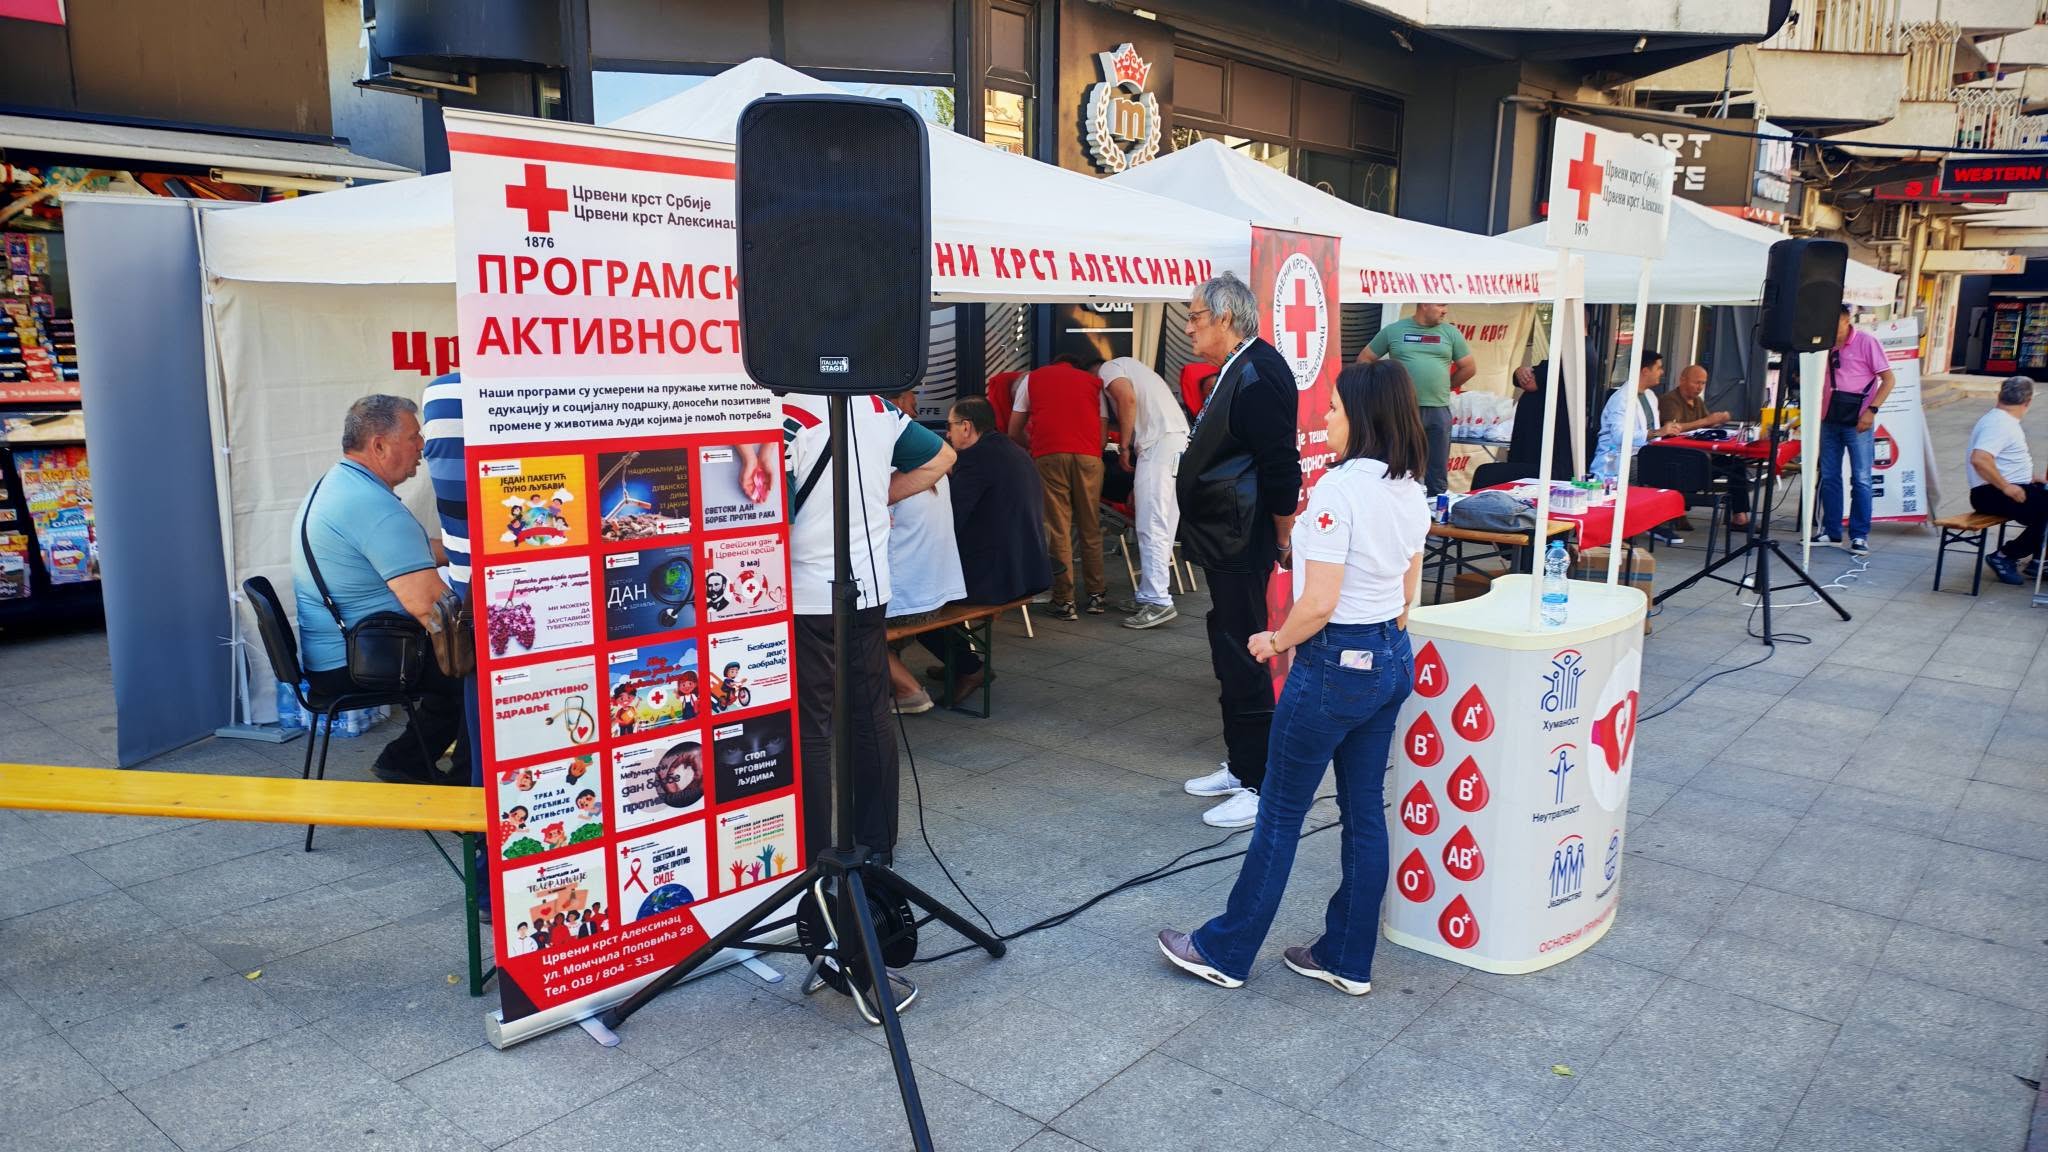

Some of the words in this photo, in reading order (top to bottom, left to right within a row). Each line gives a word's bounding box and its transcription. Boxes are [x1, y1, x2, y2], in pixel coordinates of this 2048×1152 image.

[1605, 159, 1630, 183] Црвени
[1628, 170, 1643, 188] крст
[1643, 168, 1662, 193] Србиј
[1954, 166, 2043, 182] WESTERN
[573, 185, 627, 203] Црвени
[631, 193, 662, 207] крст
[666, 193, 712, 212] Србије
[1602, 184, 1627, 208] Црвени
[1626, 195, 1641, 212] крст
[574, 204, 628, 222] Црвени
[632, 213, 664, 226] крст
[1574, 222, 1589, 237] 1876
[524, 235, 555, 248] 1876
[931, 242, 980, 277] НИ
[990, 247, 1058, 280] КРСТ
[1069, 252, 1212, 286] АЛЕКСИНАЦ
[477, 254, 741, 300] ПРОГРАМСК
[1359, 269, 1419, 297] ЦРВЕНИ
[1420, 273, 1456, 294] КРСТ
[1466, 272, 1540, 296] АЛЕКСИНАЦ
[476, 316, 743, 356] АКТИВНОСТ
[1480, 323, 1509, 344] крст
[392, 331, 460, 376] Цр
[479, 388, 515, 398] Наши
[517, 387, 576, 400] програми
[578, 388, 591, 397] су
[592, 385, 645, 397] усмерени
[647, 385, 660, 393] на
[662, 384, 706, 395] пружање
[708, 383, 738, 391] хитне
[488, 403, 549, 417] едукацију
[552, 404, 560, 412] и
[563, 401, 619, 413] социјалну
[621, 402, 671, 412] подршку,
[672, 399, 719, 410] доносећи
[721, 397, 771, 406] позитивне
[489, 421, 542, 434] промене
[544, 421, 551, 431] у
[554, 418, 614, 430] животима
[616, 417, 645, 428] људи
[647, 415, 683, 426] којима
[684, 414, 693, 425] је
[695, 412, 727, 422] помоћ
[729, 411, 772, 420] потребна
[500, 476, 526, 486] ЈЕДАН
[528, 482, 565, 491] ЉУБАВИ
[704, 505, 737, 515] СВЕТСКИ
[739, 504, 755, 513] ДАН
[705, 515, 728, 525] БОРБЕ
[729, 512, 757, 522] ПРОТИВ
[758, 510, 776, 519] РАКА
[746, 558, 761, 568] мај
[607, 583, 647, 609] ДАН
[495, 683, 589, 706] РЕПРОДУКТИВНО
[495, 703, 551, 720] ЗДРАВЉЕ
[1542, 717, 1580, 732] Хуманост
[744, 750, 767, 761] СТОП
[734, 759, 777, 775] ТРГОВИНИ
[737, 771, 775, 786] ЉУДИМА
[534, 791, 554, 800] ТРКА
[621, 783, 645, 798] дан
[653, 870, 675, 886] СИДЕ
[542, 944, 590, 965] Црвени
[592, 933, 619, 951] крст
[620, 914, 682, 942] Алексинац
[1539, 928, 1583, 953] ОСНОВНИ
[543, 970, 561, 984] ул.
[563, 951, 620, 976] Момчила
[622, 932, 678, 956] Поповића
[679, 924, 694, 937] 28
[545, 984, 569, 998] Тел.
[571, 974, 593, 989] 018
[602, 963, 625, 979] 804
[635, 952, 655, 967] 331
